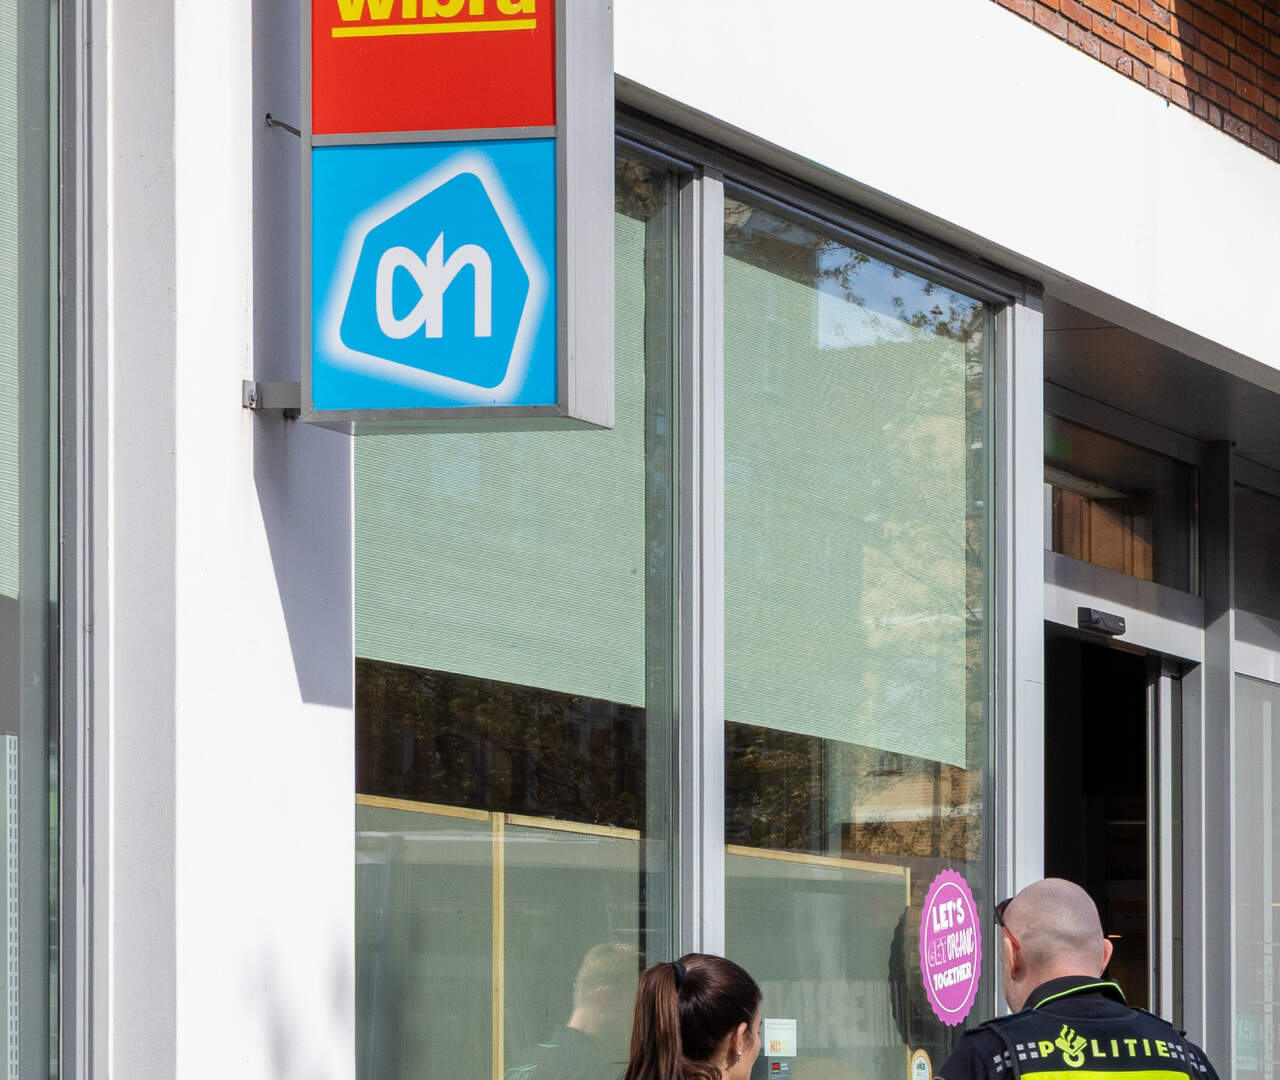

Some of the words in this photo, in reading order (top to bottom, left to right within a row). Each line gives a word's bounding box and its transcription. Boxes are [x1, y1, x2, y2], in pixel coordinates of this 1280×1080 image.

[932, 898, 965, 933] LET'S
[928, 936, 948, 967] GET
[946, 927, 974, 961] ORGANIC
[933, 962, 973, 991] TOGETHER
